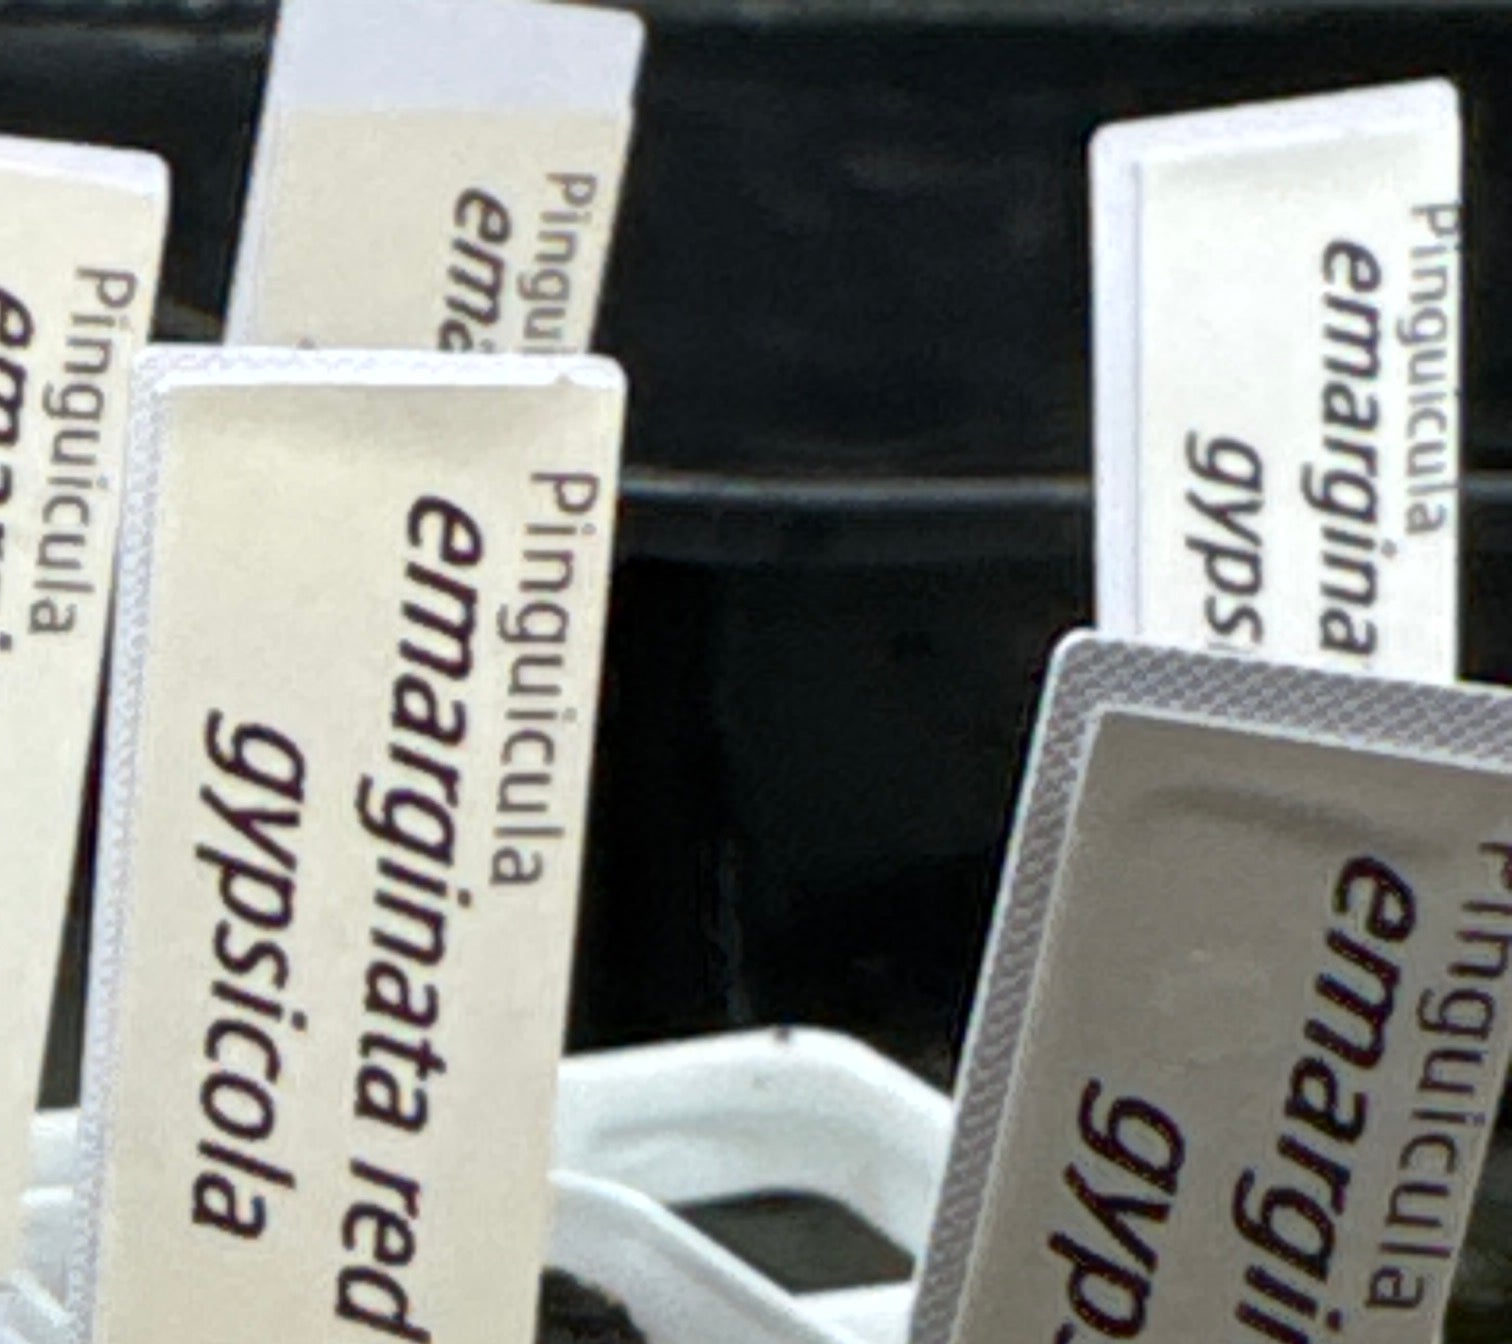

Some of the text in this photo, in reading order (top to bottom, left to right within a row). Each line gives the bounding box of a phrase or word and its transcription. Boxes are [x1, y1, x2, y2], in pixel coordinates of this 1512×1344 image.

[28, 268, 138, 634] Pinguicula
[1395, 201, 1462, 535] Pinguicula
[354, 496, 484, 1133] emarginata
[490, 472, 600, 886] Pinguicula
[192, 710, 307, 1239] gypsicola
